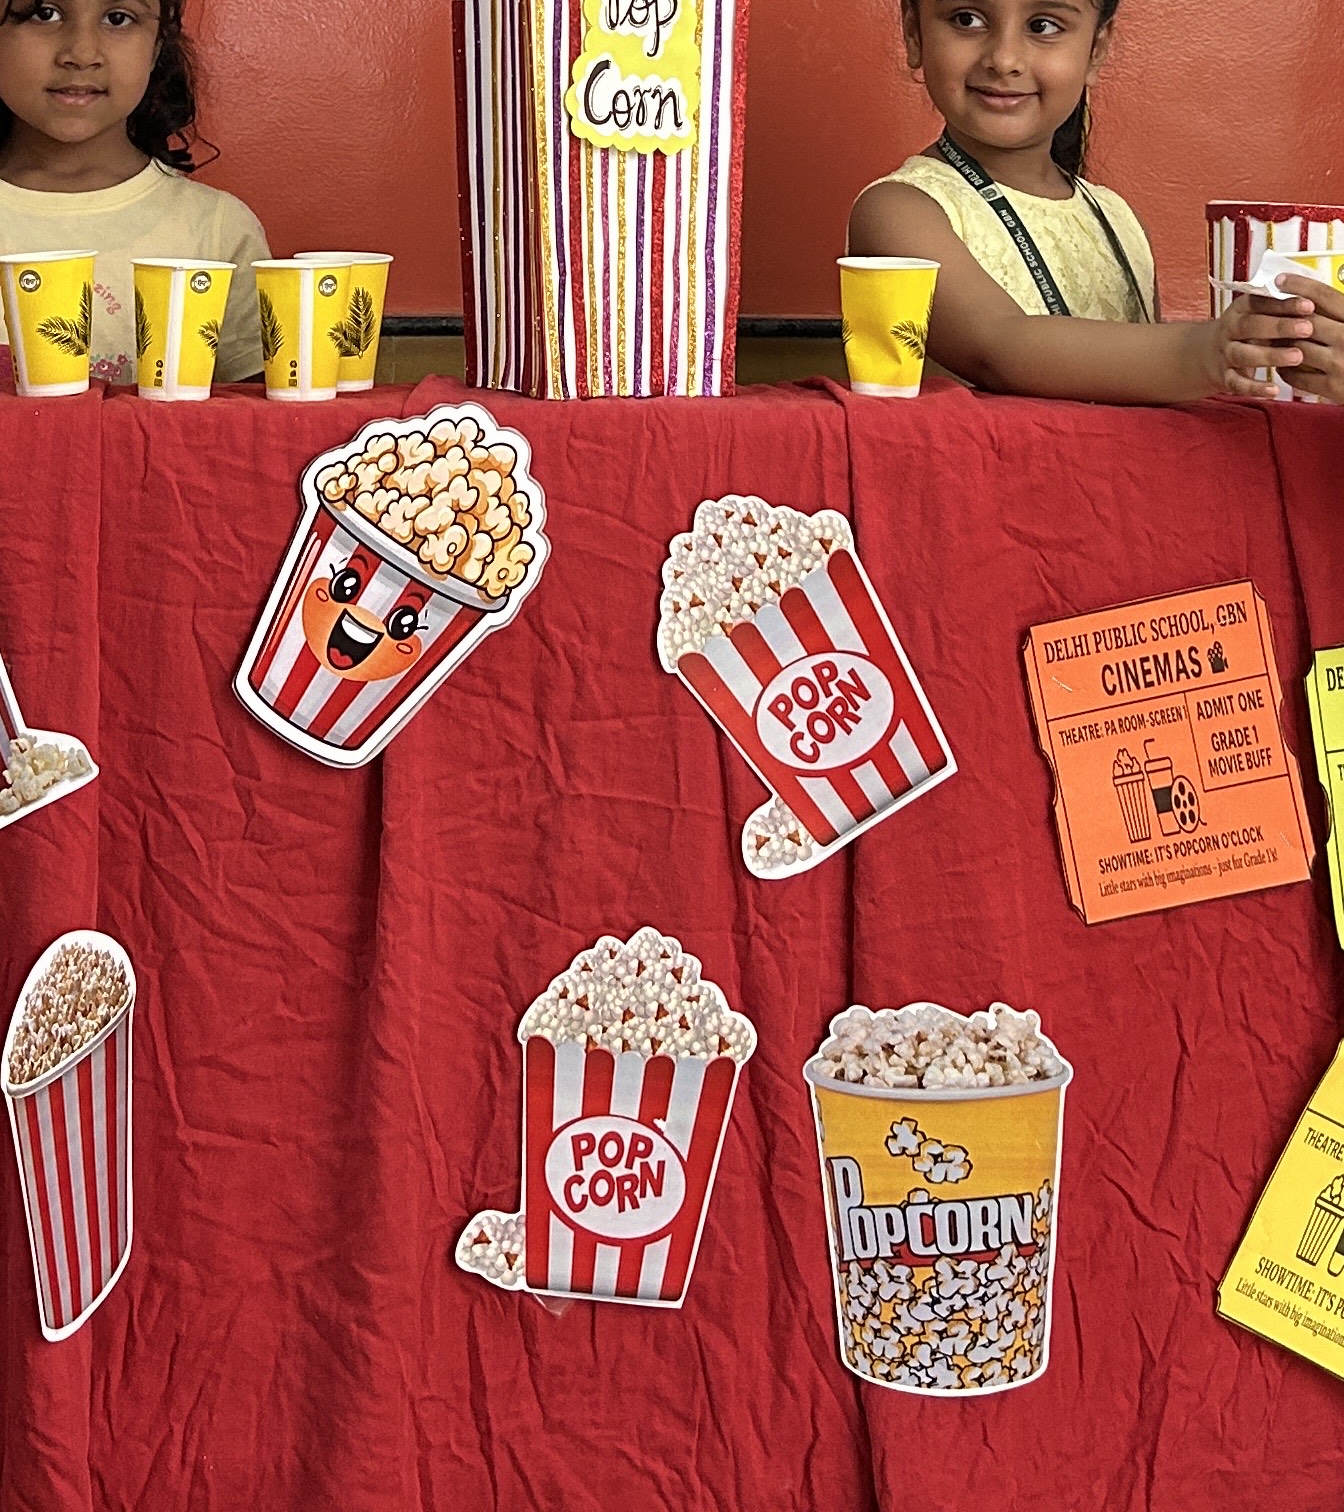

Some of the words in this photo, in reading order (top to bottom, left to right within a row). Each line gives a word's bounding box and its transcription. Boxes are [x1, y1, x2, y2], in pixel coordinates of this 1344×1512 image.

[584, 59, 683, 130] Corn
[999, 209, 1016, 228] GBN
[1044, 634, 1091, 664] DELHI
[1094, 622, 1147, 654] PUBLIC
[1150, 609, 1215, 642] SCHOOL,
[1216, 601, 1248, 626] GBN
[767, 660, 838, 731] POP
[1102, 646, 1203, 696] CINEMAS
[790, 668, 872, 763] CORN
[1058, 724, 1103, 747] THEATRE:
[1104, 719, 1117, 736] PA
[1118, 706, 1183, 733] ROOM-SCREEN
[1196, 695, 1235, 720] ADMIT
[1238, 689, 1265, 712] ONE
[1208, 753, 1245, 777] MOVIE
[1246, 747, 1272, 769] BUFF
[1211, 728, 1250, 752] GRADE
[1252, 725, 1259, 744] 1
[1098, 849, 1154, 874] SHOWTIME:
[1155, 844, 1172, 863] IT'S
[1174, 833, 1219, 859] POPCORN
[1221, 826, 1264, 849] O'CLOCK
[571, 1131, 653, 1171] POP
[563, 1160, 666, 1213] CORN
[829, 1157, 1034, 1262] POPCORN
[1235, 1277, 1256, 1299] Little
[1255, 1288, 1273, 1307] stars
[1273, 1299, 1291, 1315] with
[1255, 1257, 1315, 1301] SHOWTIME:
[1314, 1287, 1337, 1311] IT'S
